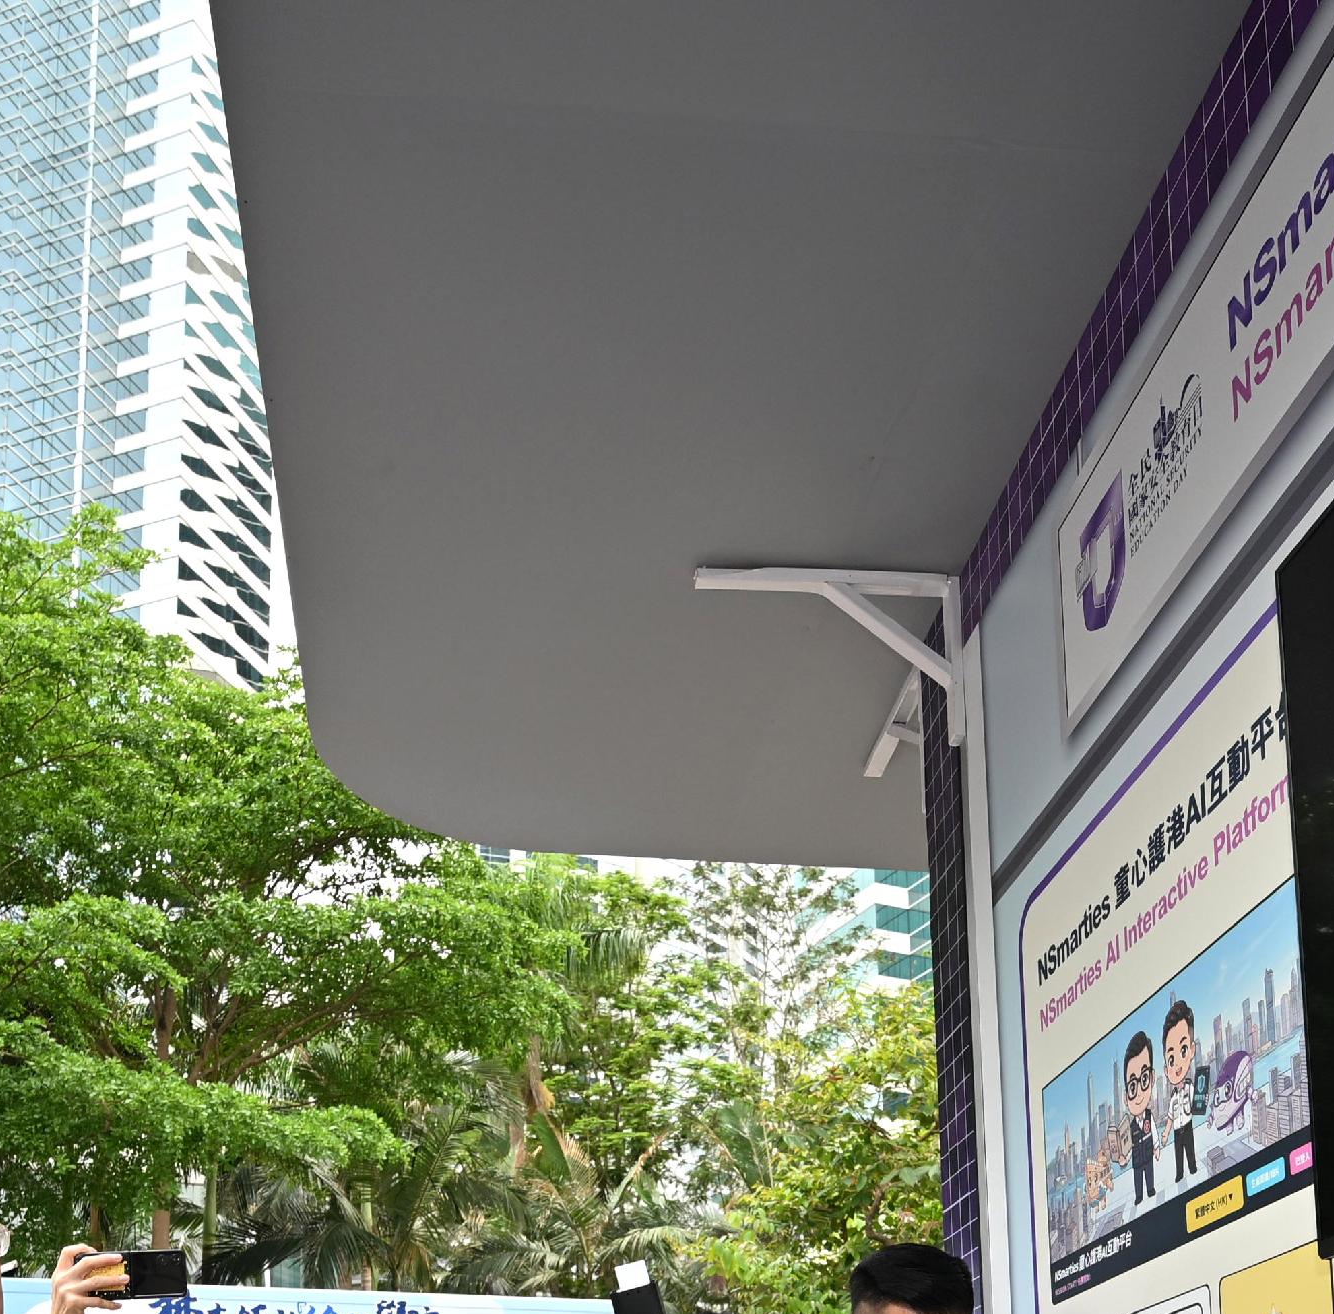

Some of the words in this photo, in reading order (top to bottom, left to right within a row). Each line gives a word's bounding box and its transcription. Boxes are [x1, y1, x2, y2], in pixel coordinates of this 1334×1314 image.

[1129, 486, 1165, 543] NATIONAL
[1165, 426, 1203, 524] SECURITY
[1130, 494, 1171, 559] EDUCATION
[1172, 464, 1189, 494] DAY
[1037, 895, 1110, 987] NSmarties
[1039, 958, 1102, 1033] NSmarties
[1106, 934, 1121, 973] AI
[1124, 854, 1209, 953] Interactive
